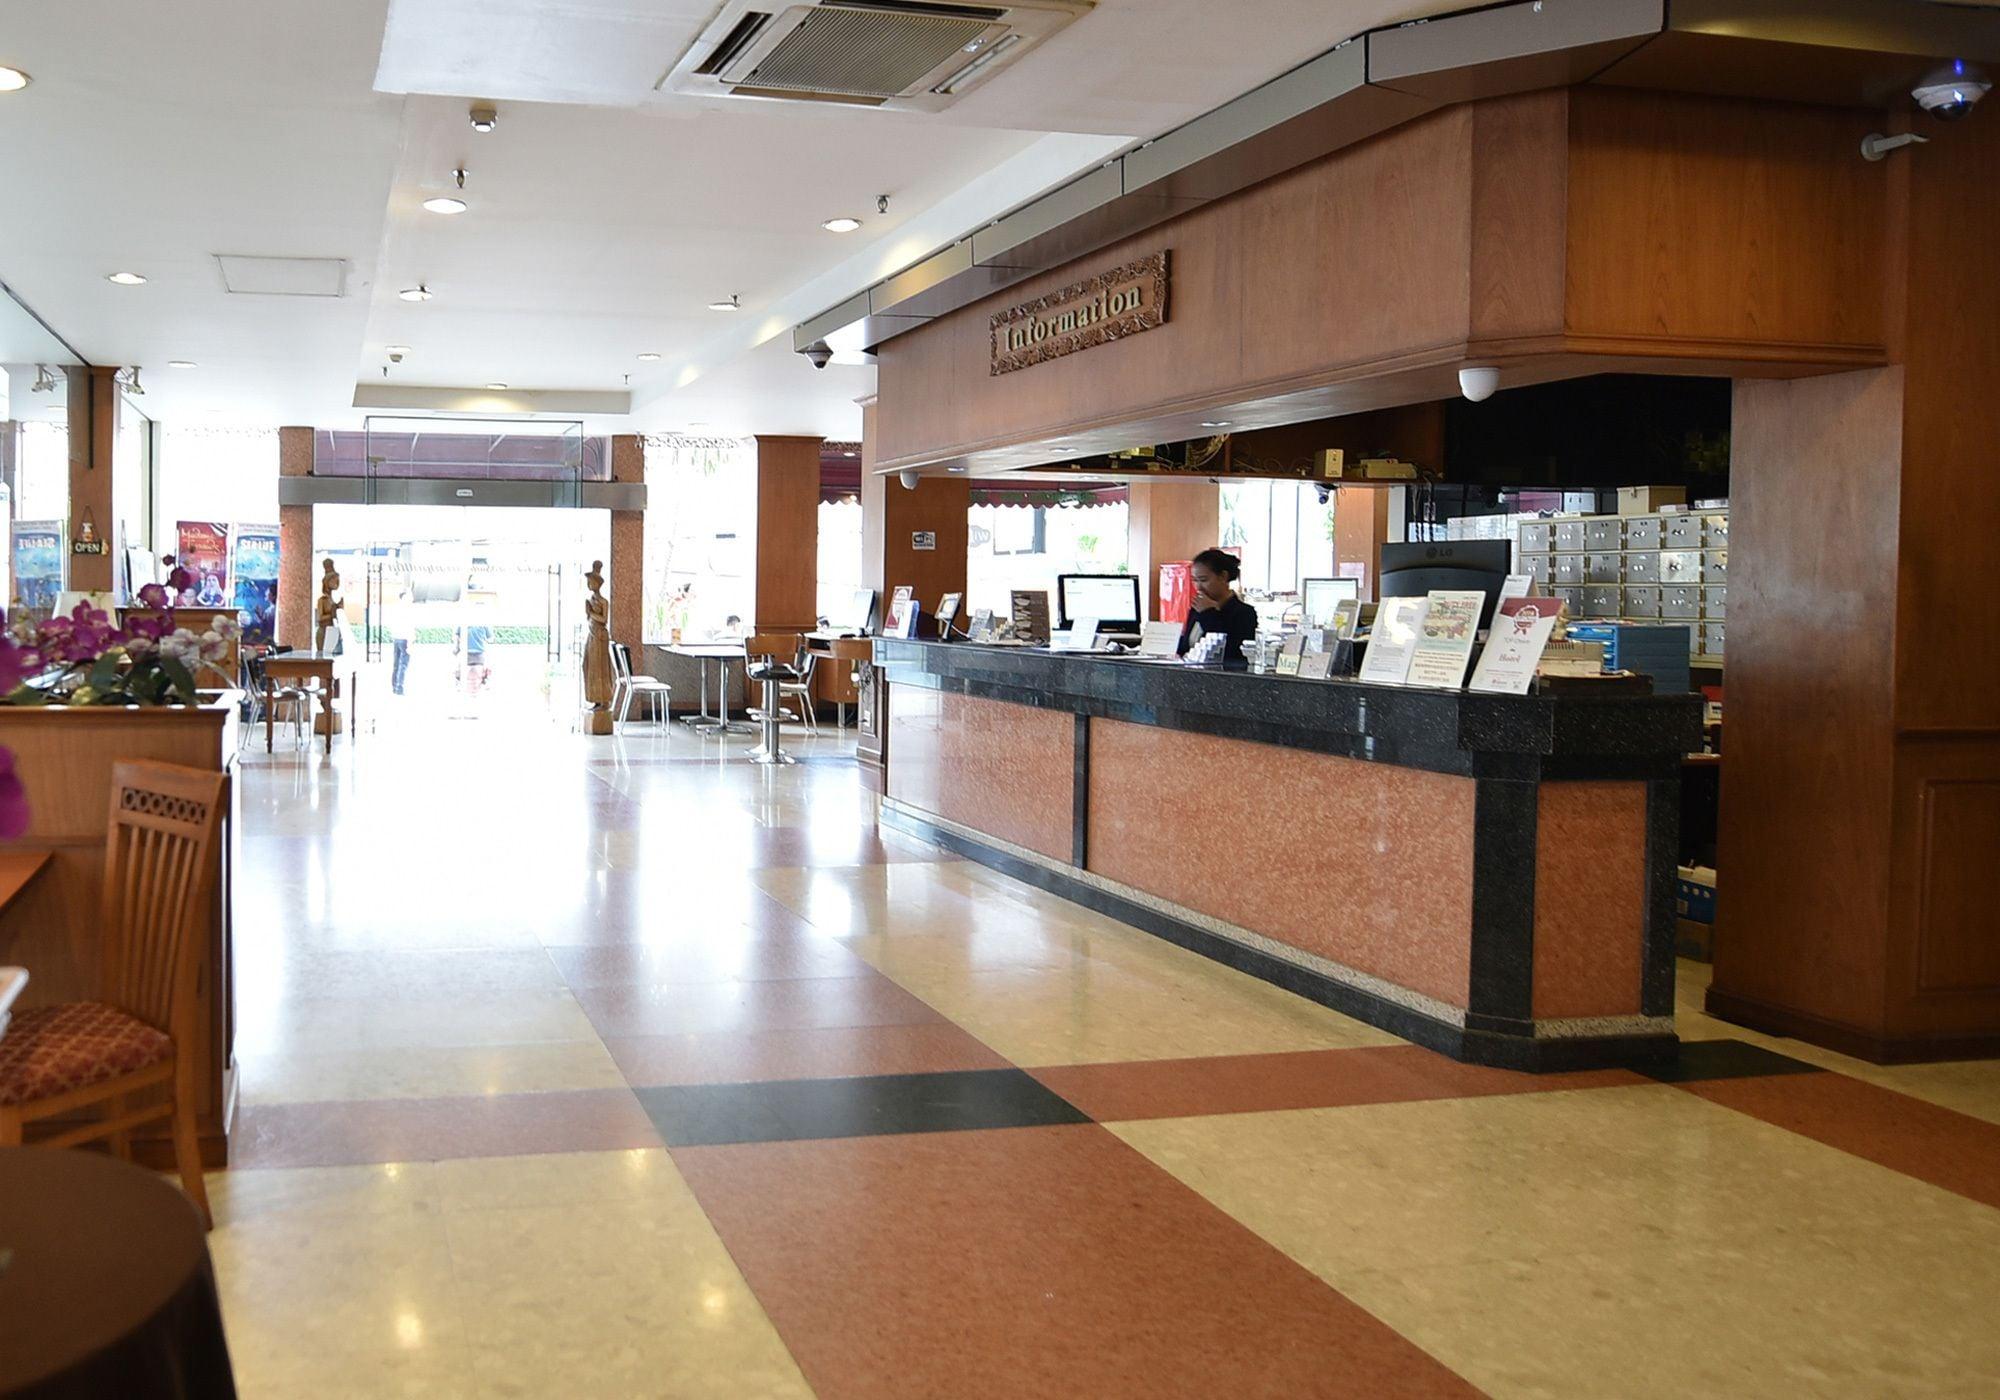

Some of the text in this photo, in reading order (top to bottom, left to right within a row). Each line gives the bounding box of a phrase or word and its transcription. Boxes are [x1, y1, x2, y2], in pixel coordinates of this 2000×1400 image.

[1003, 286, 1143, 352] Information
[75, 543, 100, 553] OPEN
[1440, 548, 1453, 557] LG
